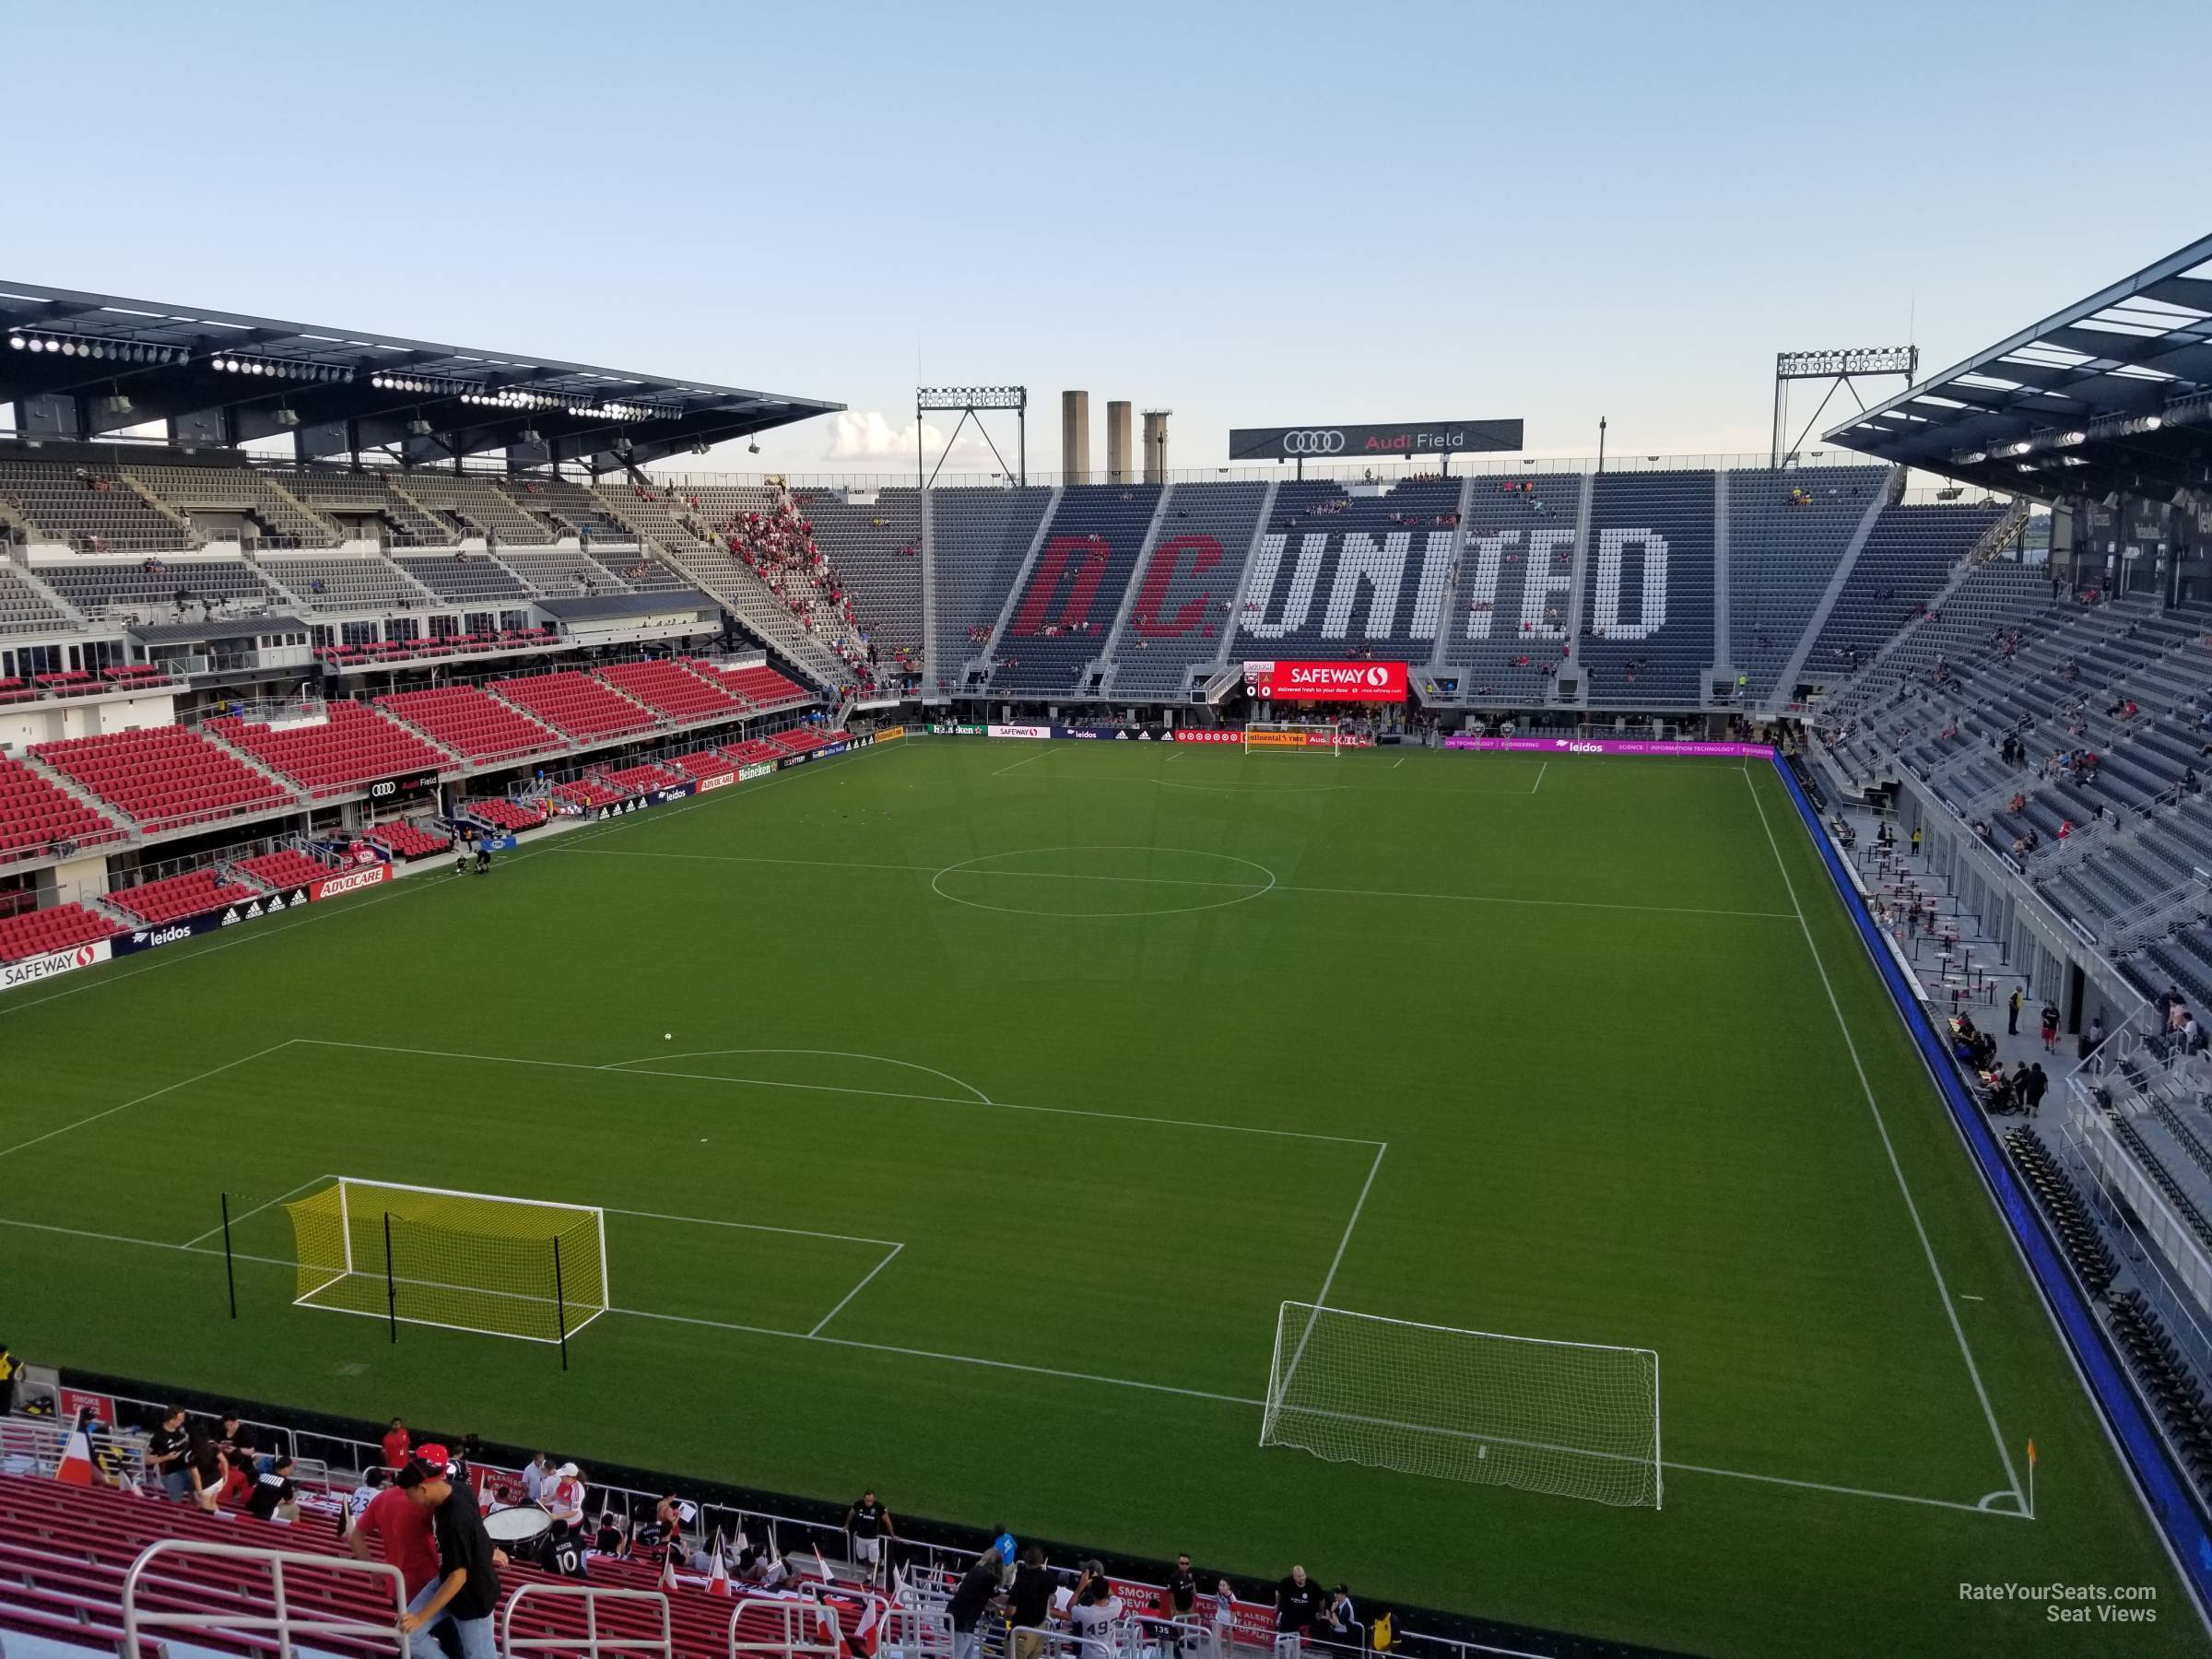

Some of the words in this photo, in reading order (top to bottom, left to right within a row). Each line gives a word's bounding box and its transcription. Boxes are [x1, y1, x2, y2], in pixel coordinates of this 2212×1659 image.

[1365, 434, 1411, 451] Audi
[1417, 431, 1464, 449] Field
[1239, 528, 1670, 640] UNITED
[1290, 668, 1366, 684] SAFEWAY
[1247, 686, 1256, 697] 0
[1261, 686, 1271, 697] 0
[1570, 741, 1603, 752] leidos
[738, 762, 771, 782] Heineken
[402, 780, 419, 790] Audi
[419, 776, 437, 787] Field
[700, 772, 735, 793] ADVOCARE
[666, 789, 687, 802] leidos
[321, 866, 383, 898] ADVOCARE
[221, 916, 241, 926] adidas
[245, 910, 265, 920] adidas
[267, 903, 287, 913] adidas
[289, 897, 308, 907] adidas
[150, 925, 192, 947] leidos
[5, 951, 75, 986] SAFEWAY
[556, 1550, 577, 1576] 10
[1118, 1585, 1161, 1602] SMOKE
[1244, 1611, 1274, 1626] ALERT!
[1154, 1625, 1170, 1635] 135
